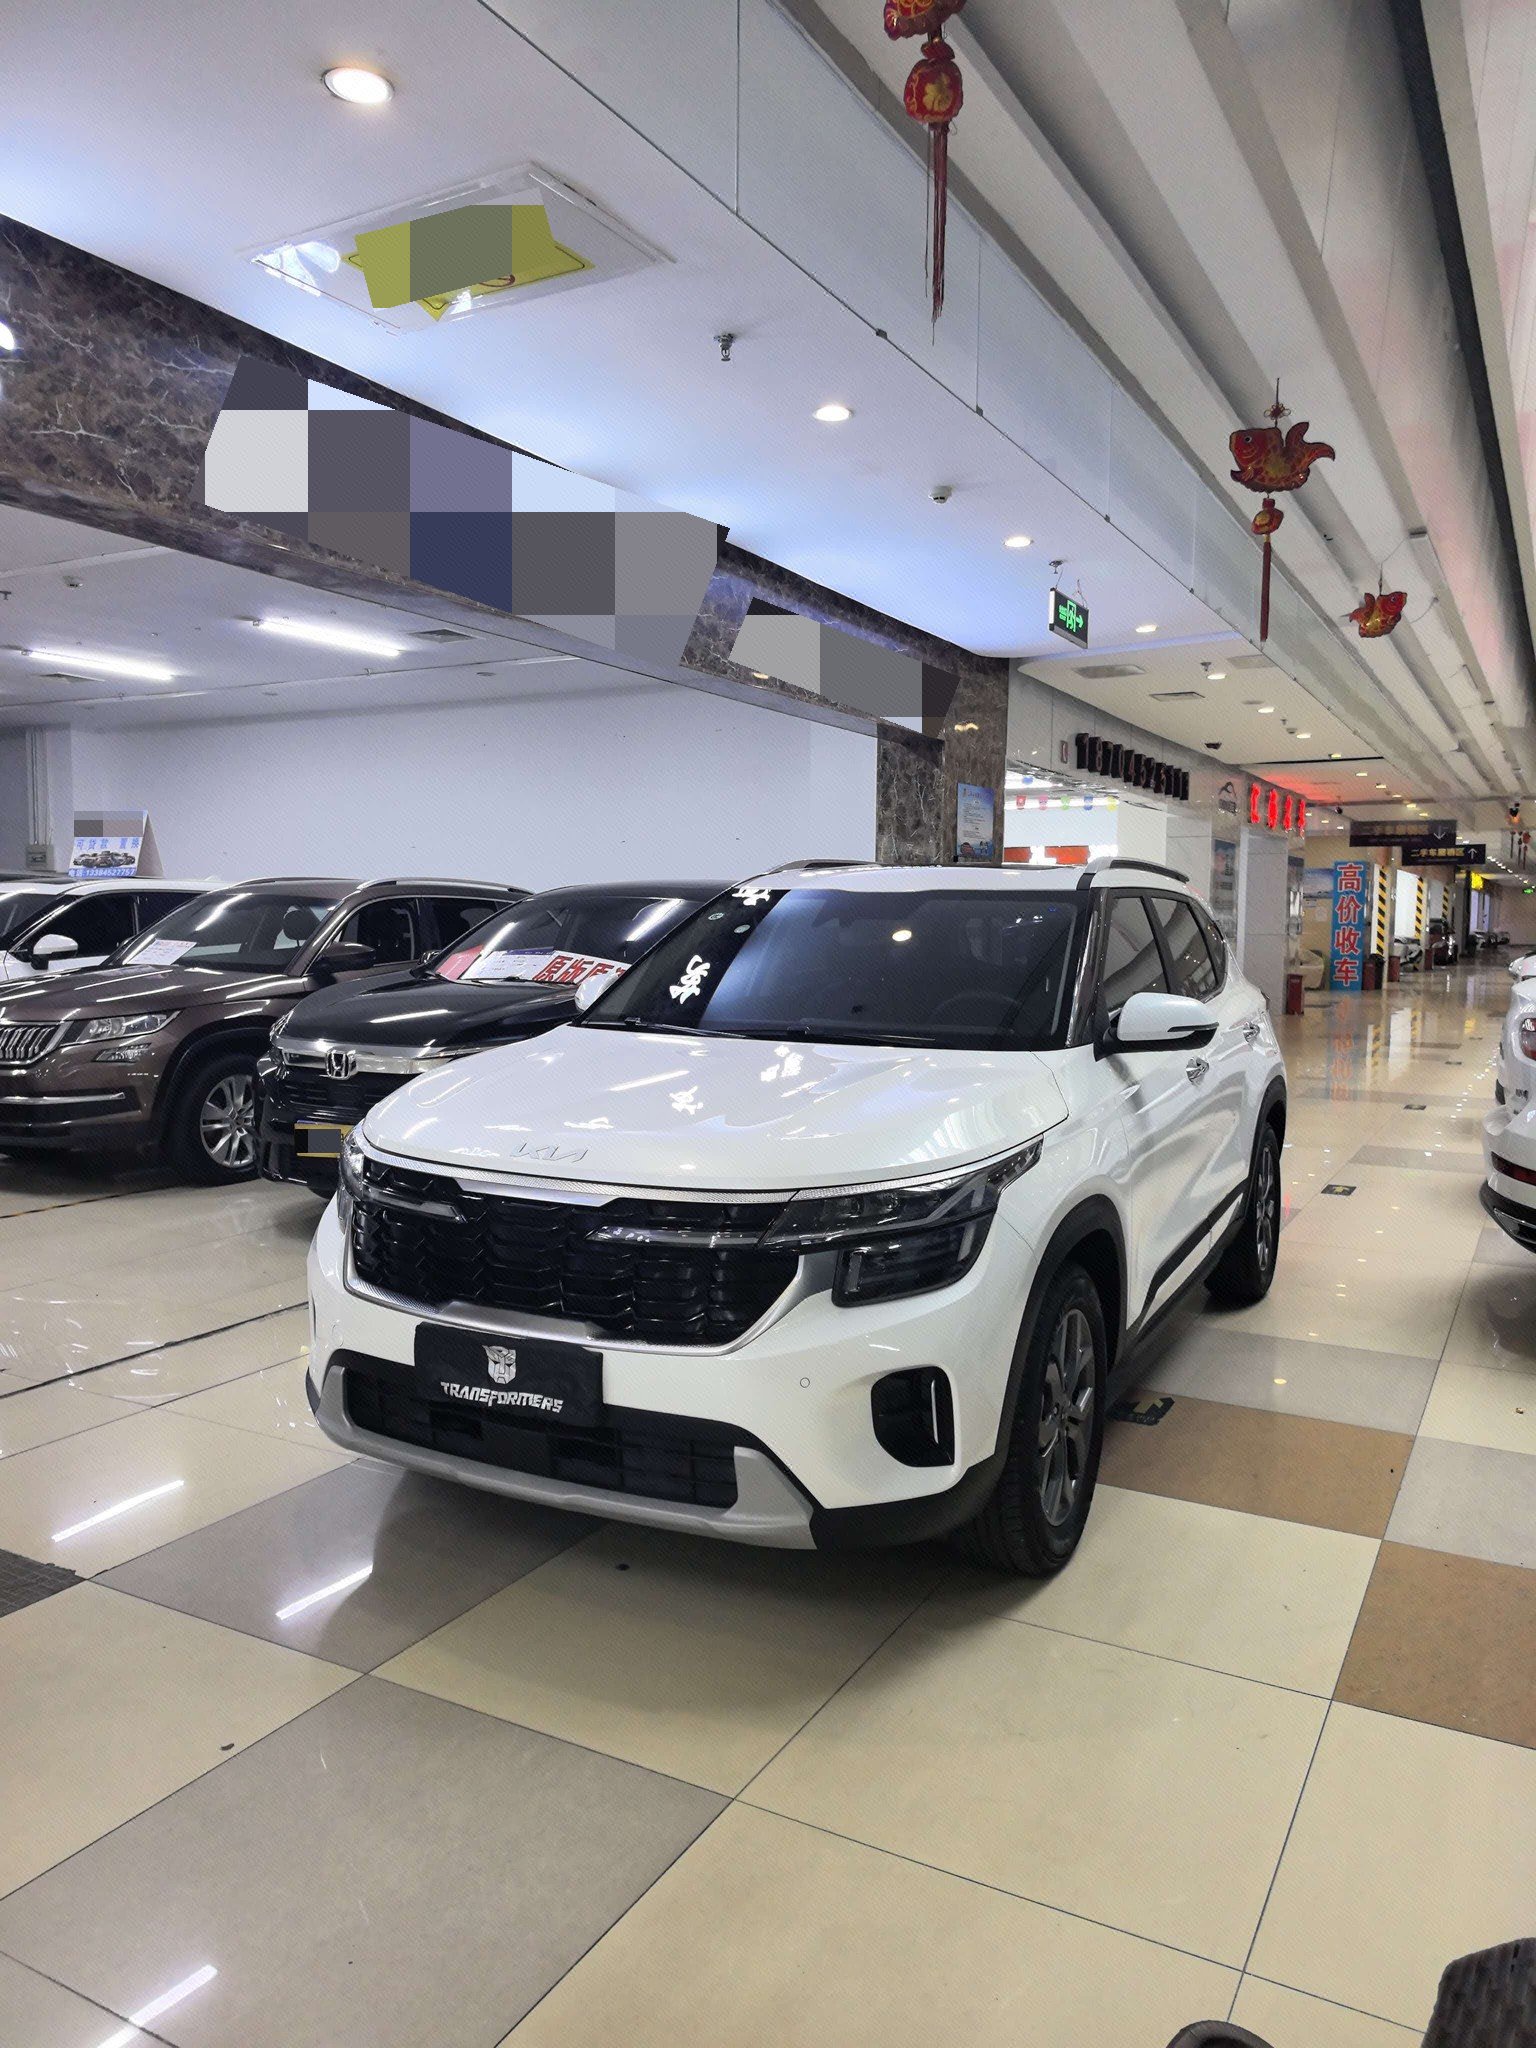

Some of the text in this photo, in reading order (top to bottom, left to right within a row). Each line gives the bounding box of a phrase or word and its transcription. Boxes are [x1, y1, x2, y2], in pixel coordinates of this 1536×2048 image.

[1333, 862, 1363, 987] 高价收车
[440, 1381, 564, 1413] TRANSFORMERS
